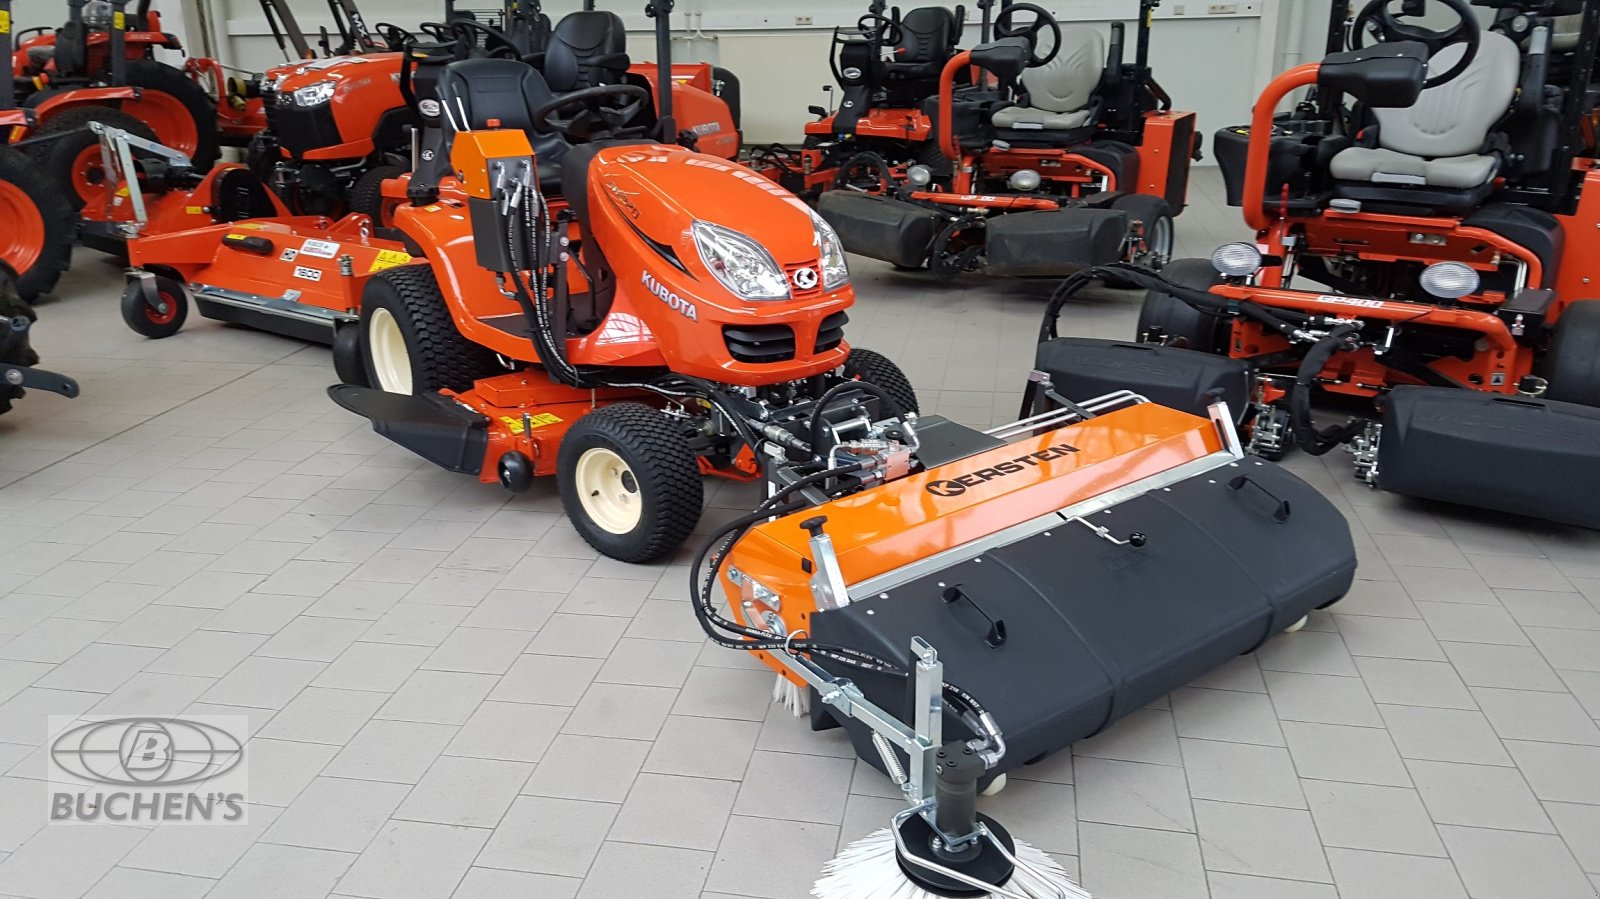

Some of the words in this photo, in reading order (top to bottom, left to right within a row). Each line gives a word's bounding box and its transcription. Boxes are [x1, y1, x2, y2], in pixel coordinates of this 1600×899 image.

[352, 13, 368, 38] MX
[641, 269, 698, 321] KUBOTA
[925, 443, 1081, 497] KERSTEN
